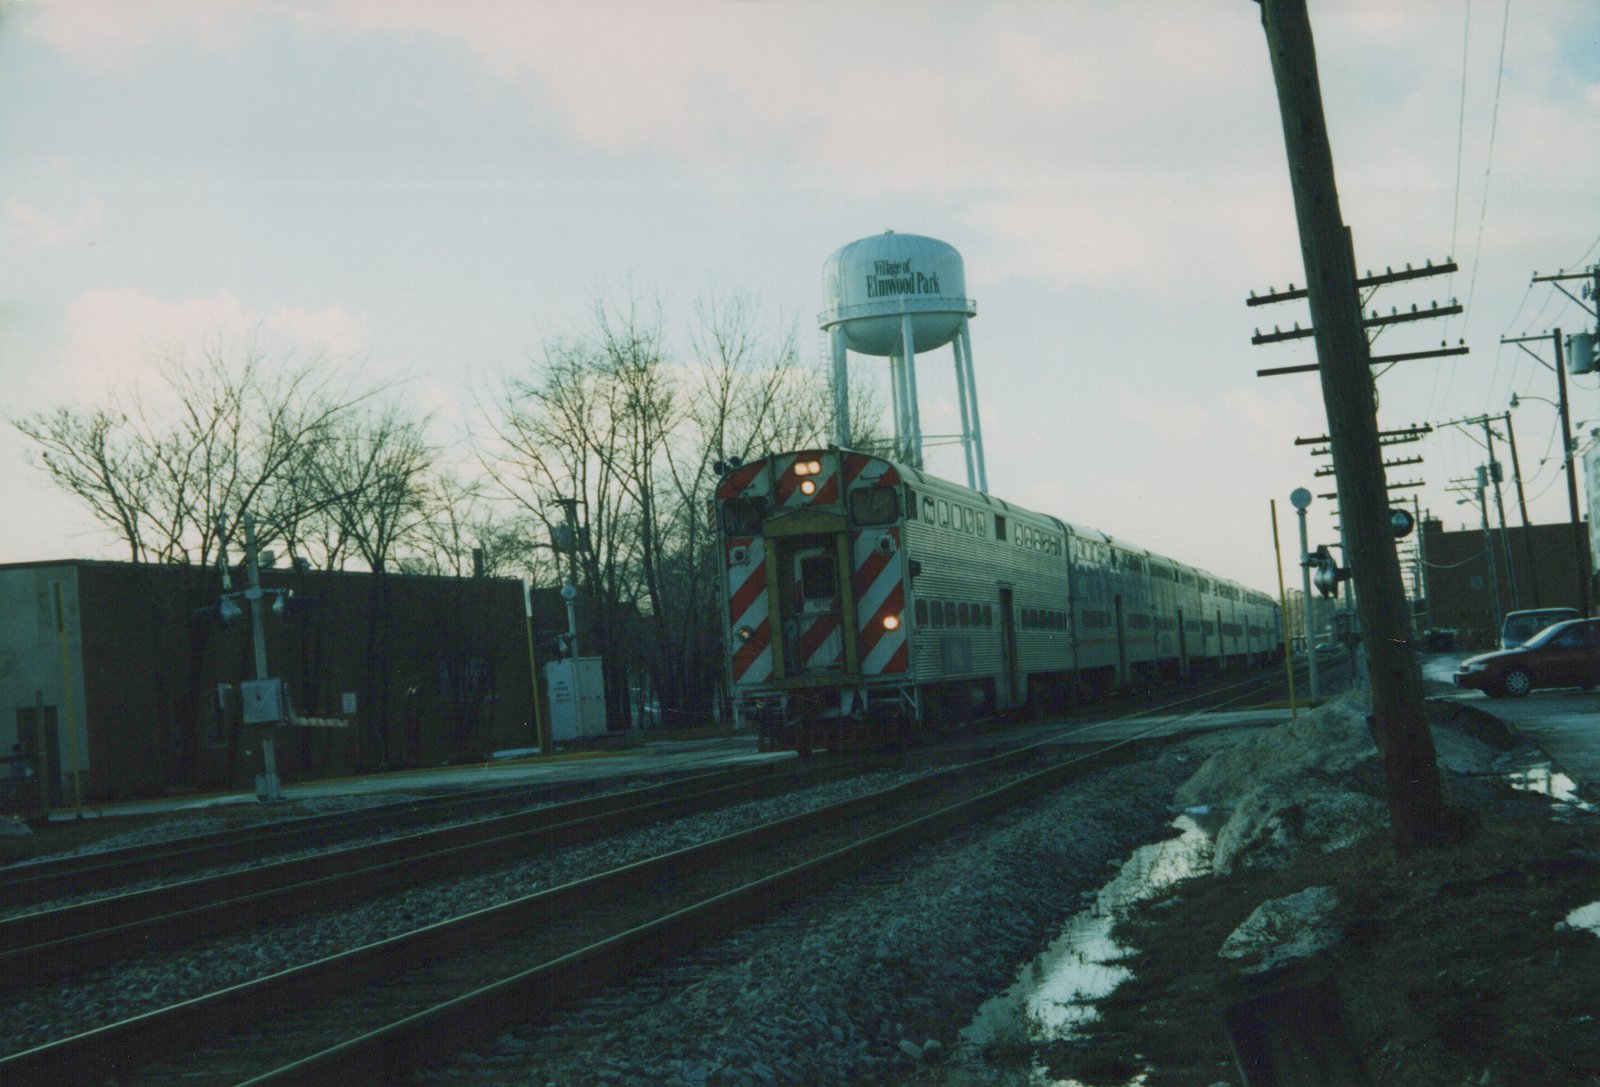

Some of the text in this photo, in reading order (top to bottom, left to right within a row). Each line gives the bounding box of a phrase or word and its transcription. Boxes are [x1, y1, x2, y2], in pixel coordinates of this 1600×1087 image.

[874, 258, 912, 277] Village of
[866, 272, 940, 298] Elmwood Park
